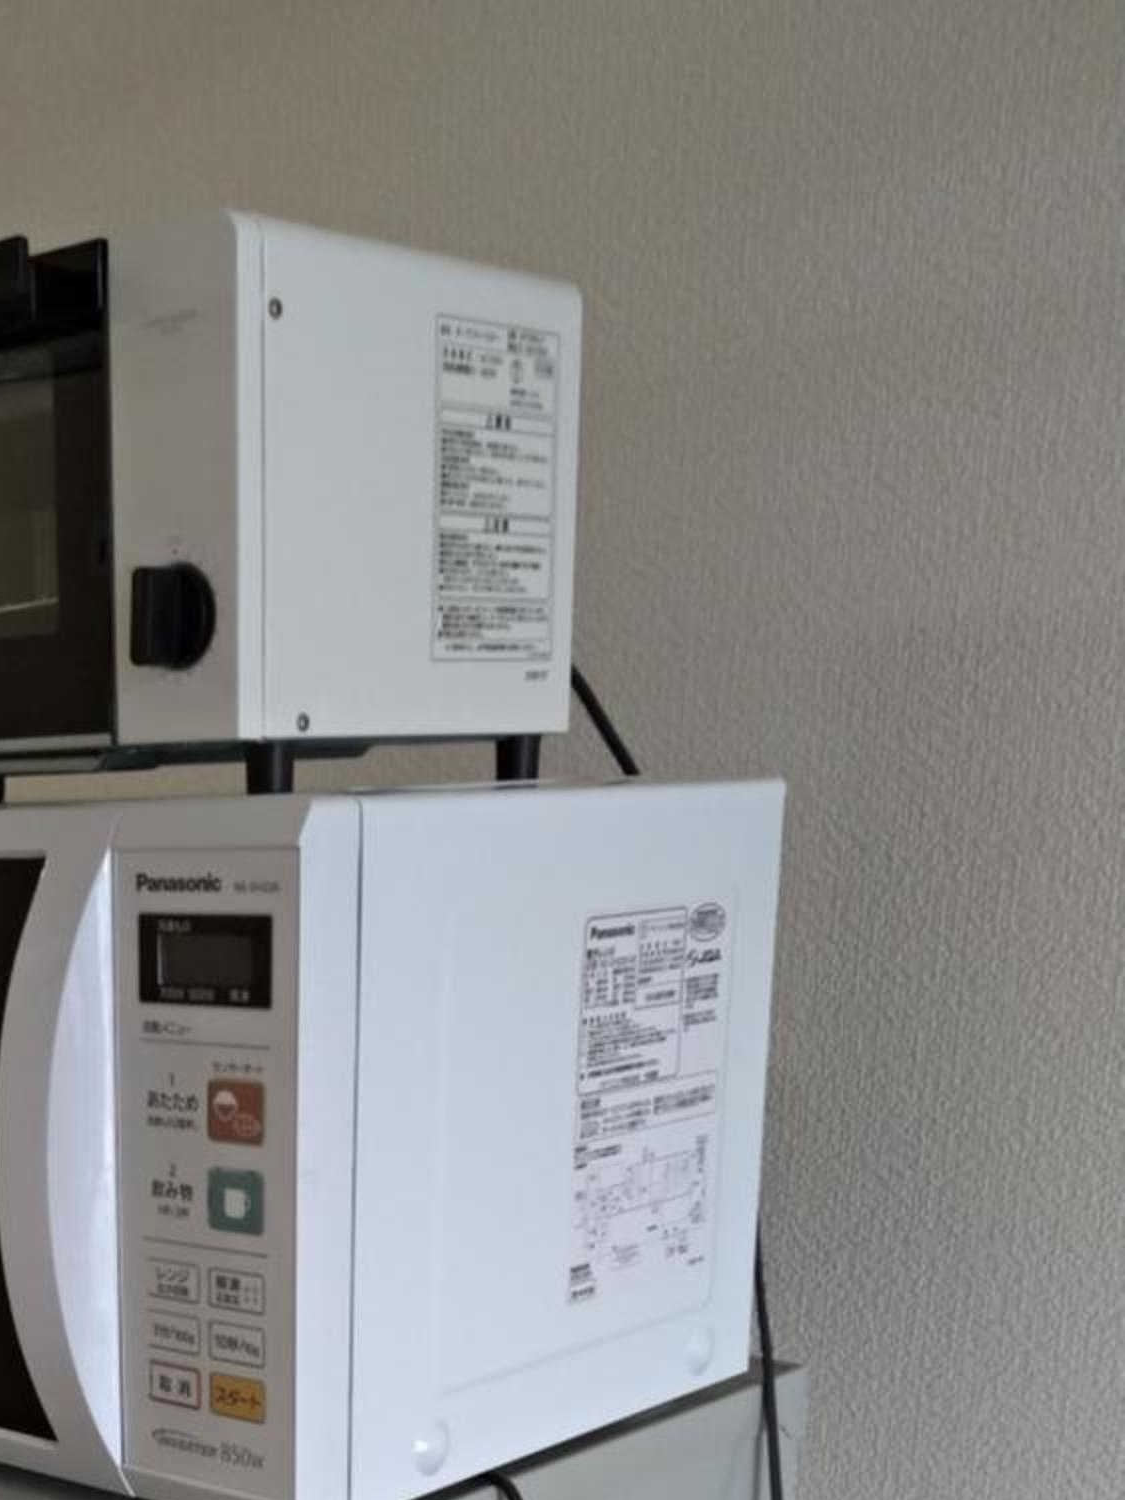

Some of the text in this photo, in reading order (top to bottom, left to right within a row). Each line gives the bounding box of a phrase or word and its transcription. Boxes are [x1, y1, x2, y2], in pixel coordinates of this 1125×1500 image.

[136, 873, 222, 892] Panasonic
[215, 1385, 262, 1410] スタート
